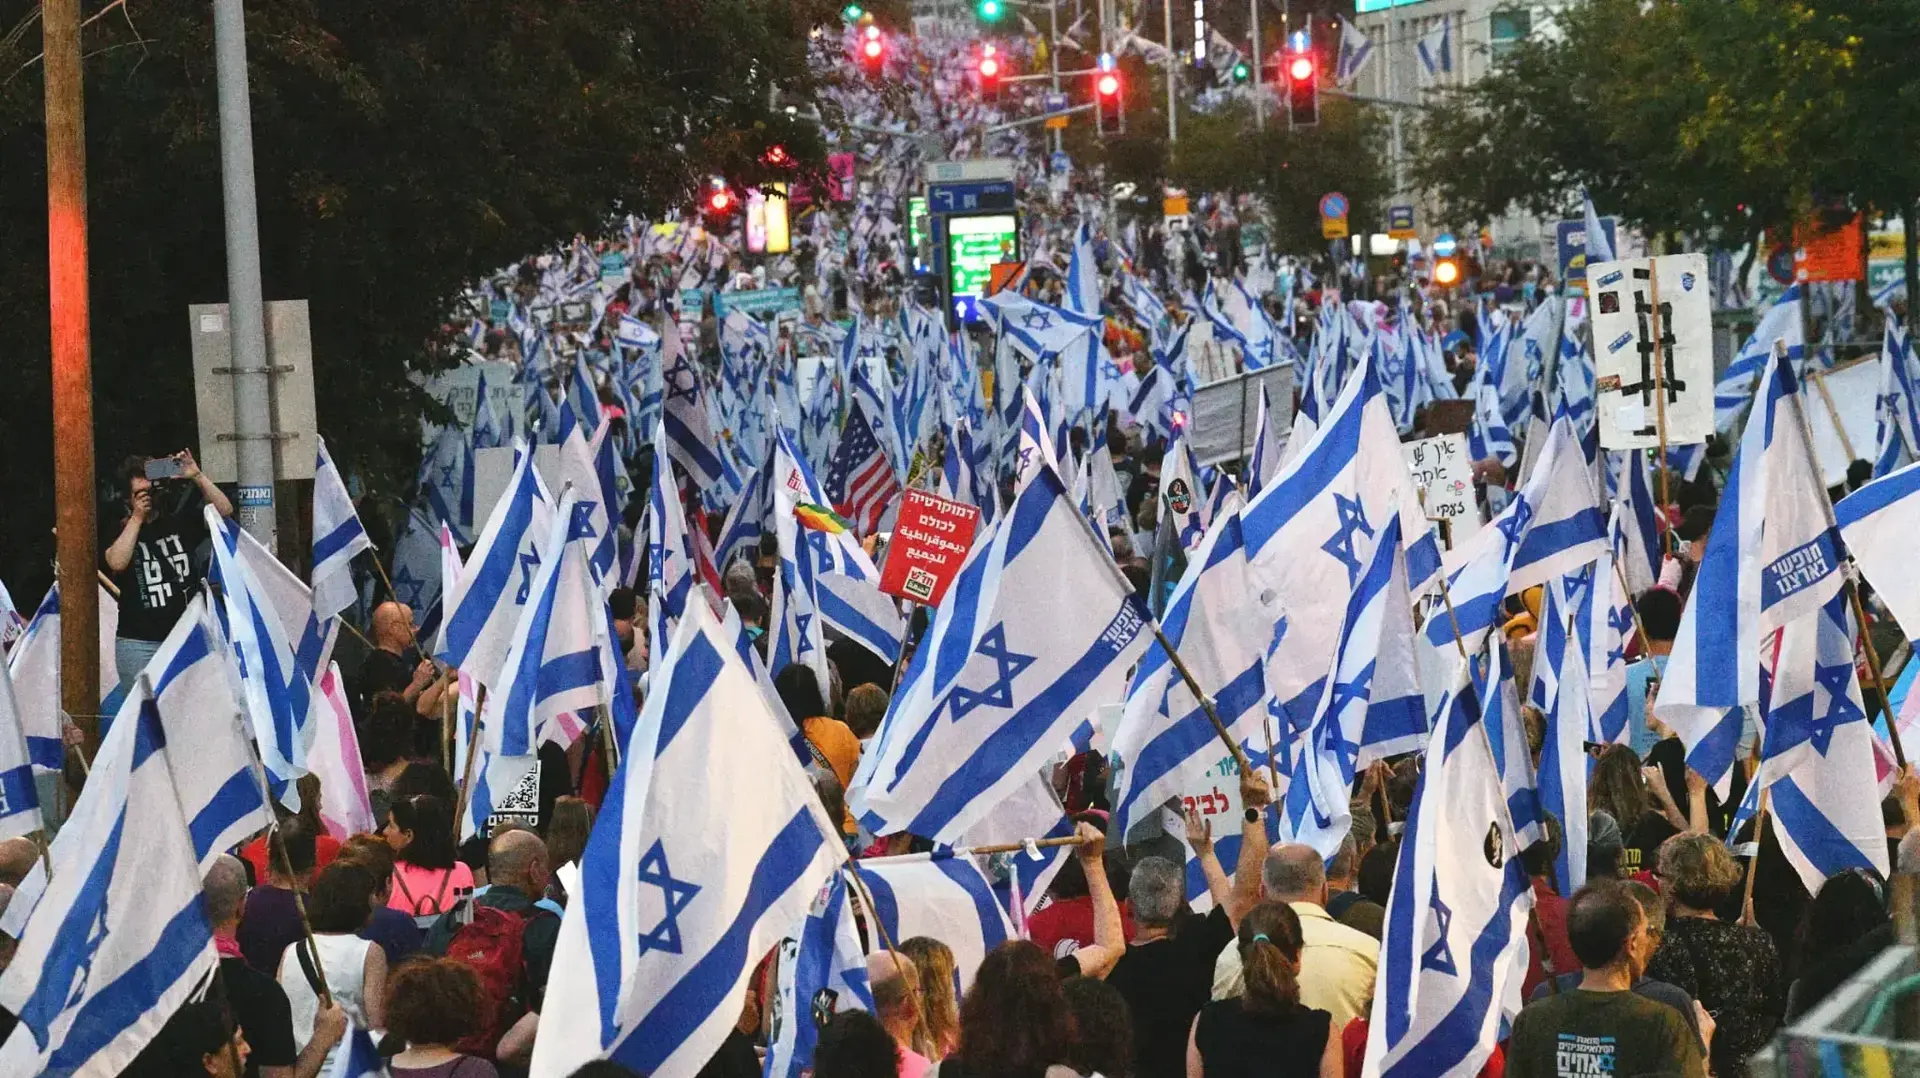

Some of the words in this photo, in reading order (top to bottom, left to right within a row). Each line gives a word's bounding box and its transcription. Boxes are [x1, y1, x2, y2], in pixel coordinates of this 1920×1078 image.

[1434, 441, 1455, 465] אין
[908, 492, 975, 520] דמוקרטיה
[919, 514, 957, 533] לכולם
[900, 525, 966, 554] ديموقراطية
[906, 546, 947, 565] للجميع
[1771, 541, 1823, 577] חופשי
[1776, 557, 1830, 596] בארצנו
[1111, 611, 1145, 652] ארצנו
[1557, 1051, 1602, 1074] אחים
